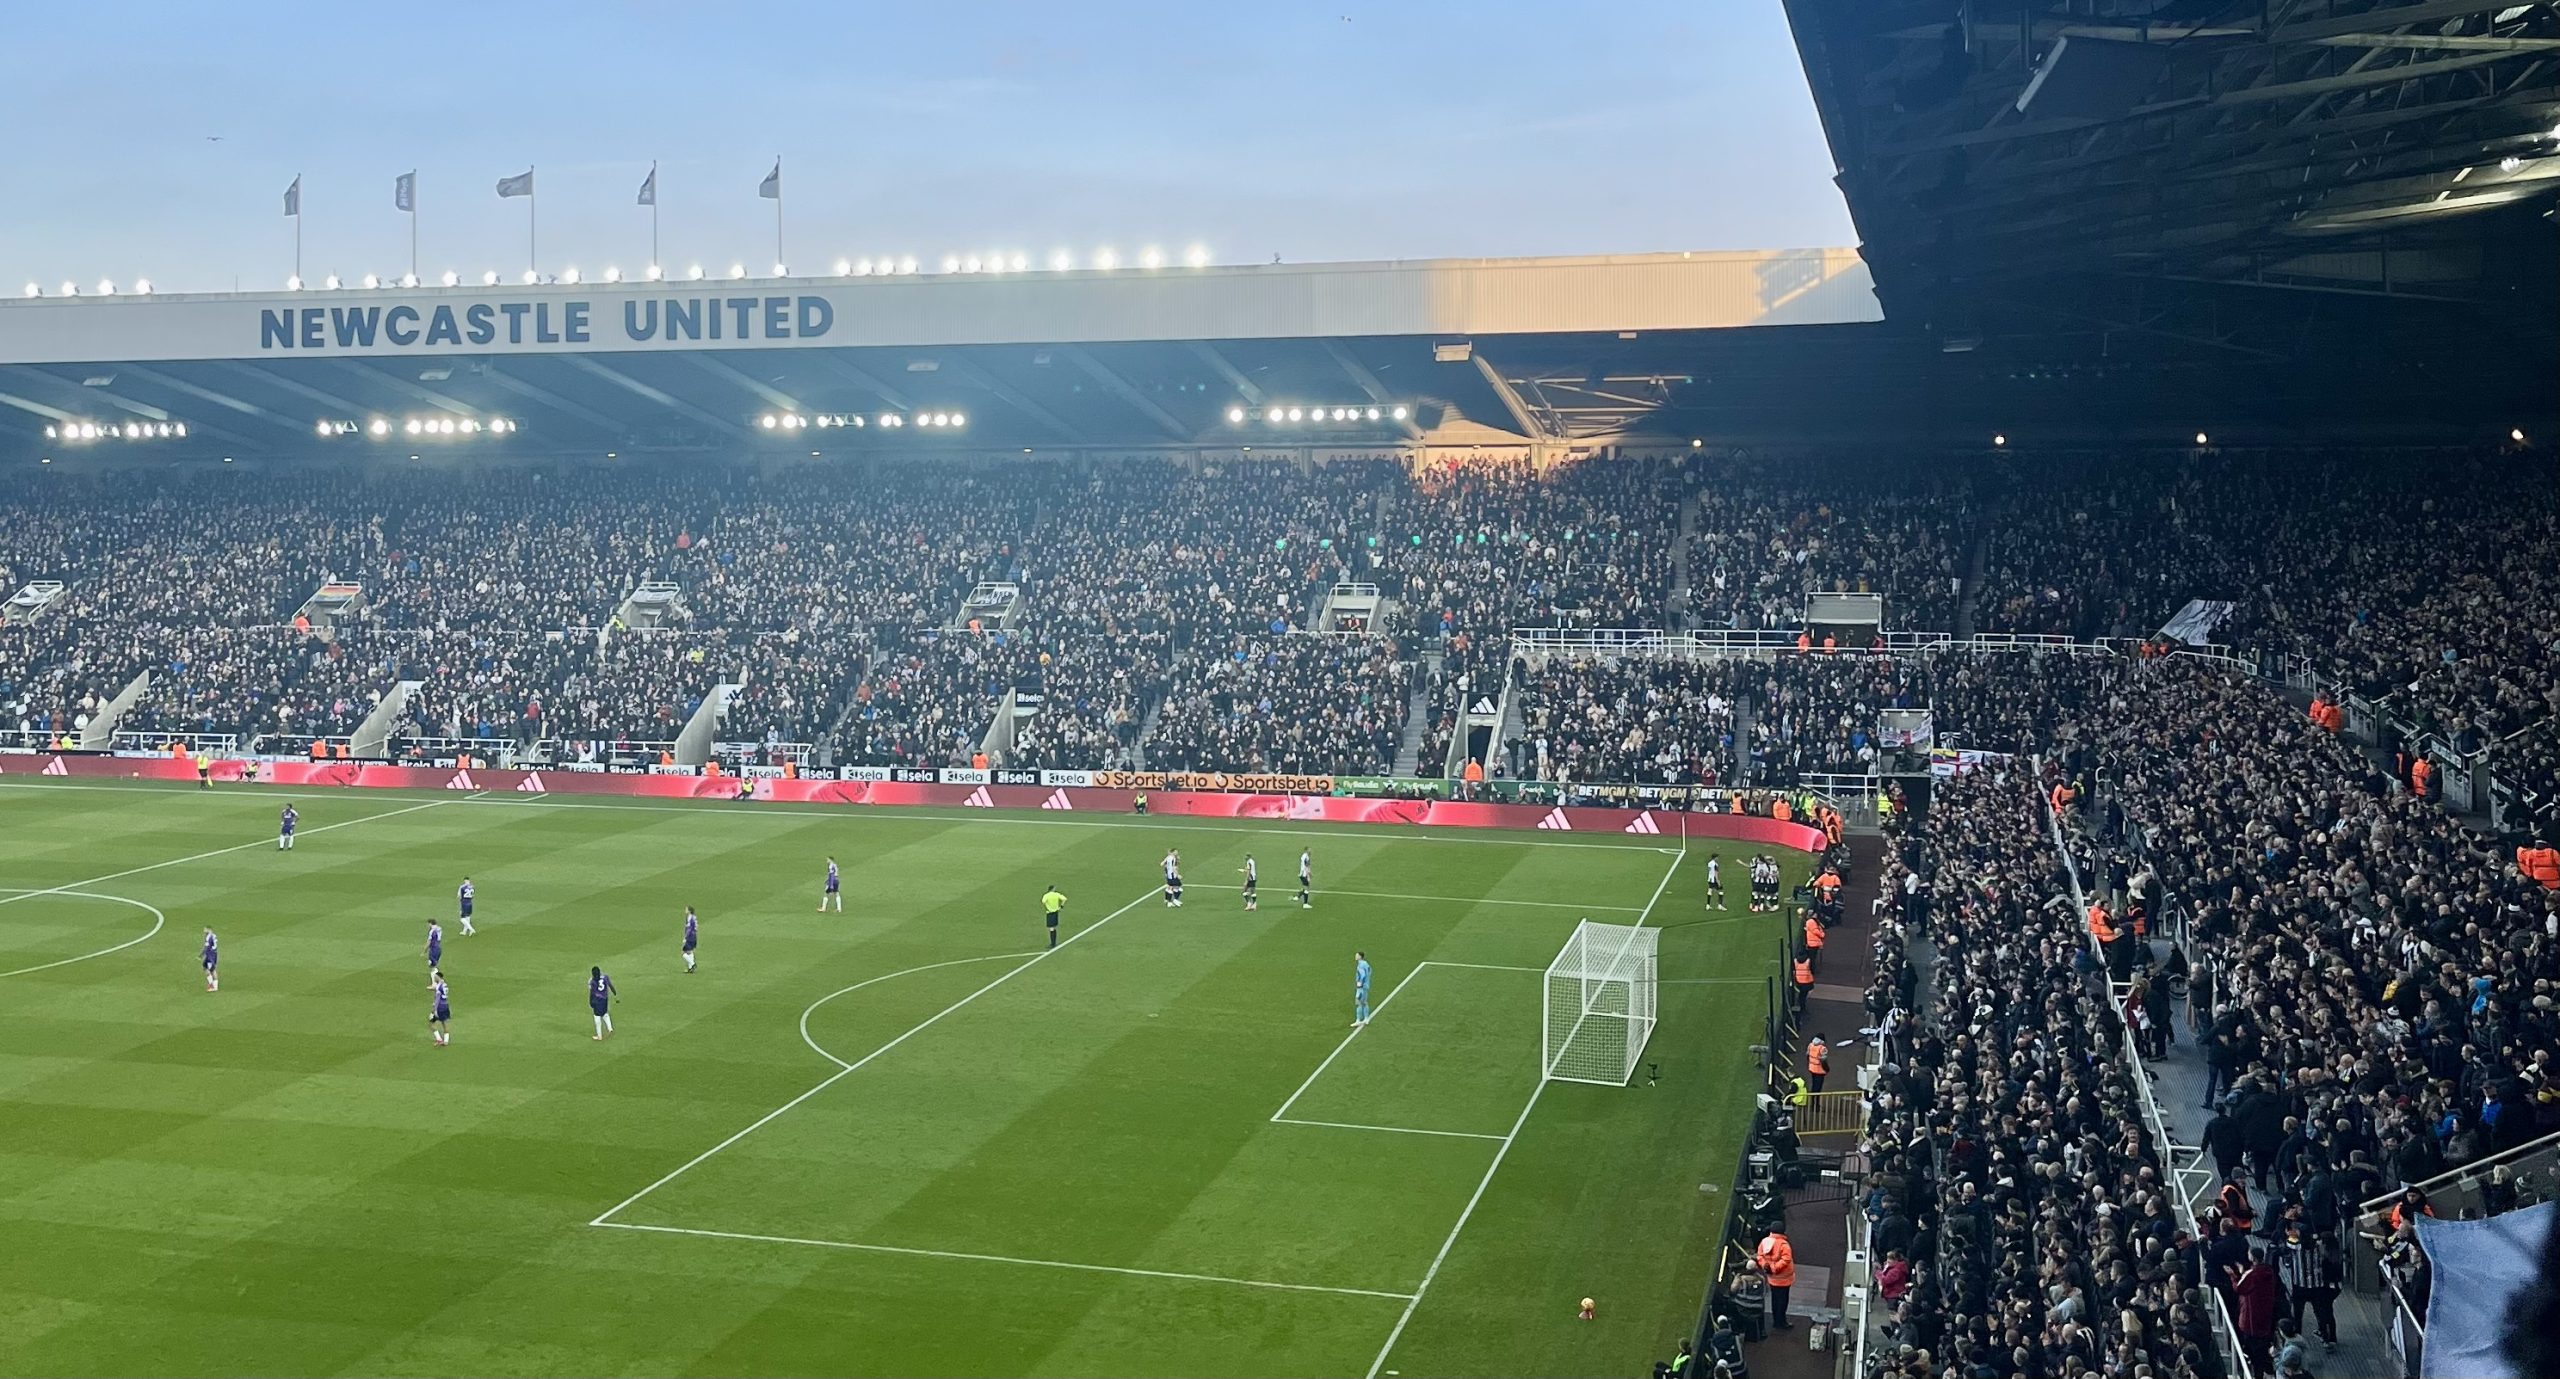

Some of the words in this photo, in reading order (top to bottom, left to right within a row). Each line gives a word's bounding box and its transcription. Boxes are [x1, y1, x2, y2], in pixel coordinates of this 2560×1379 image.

[261, 301, 590, 350] NEWCASTLE
[623, 295, 834, 342] UNITED
[810, 768, 835, 780] sela
[859, 769, 883, 781] sela
[908, 770, 934, 782] sela
[959, 771, 983, 783] sela
[1009, 772, 1035, 784] sela
[1060, 774, 1085, 785] sela
[1233, 774, 1330, 791] Sportsbet.io
[1579, 785, 1627, 797] BETMGM
[1638, 787, 1687, 798] BETMGM
[597, 979, 606, 992] 3
